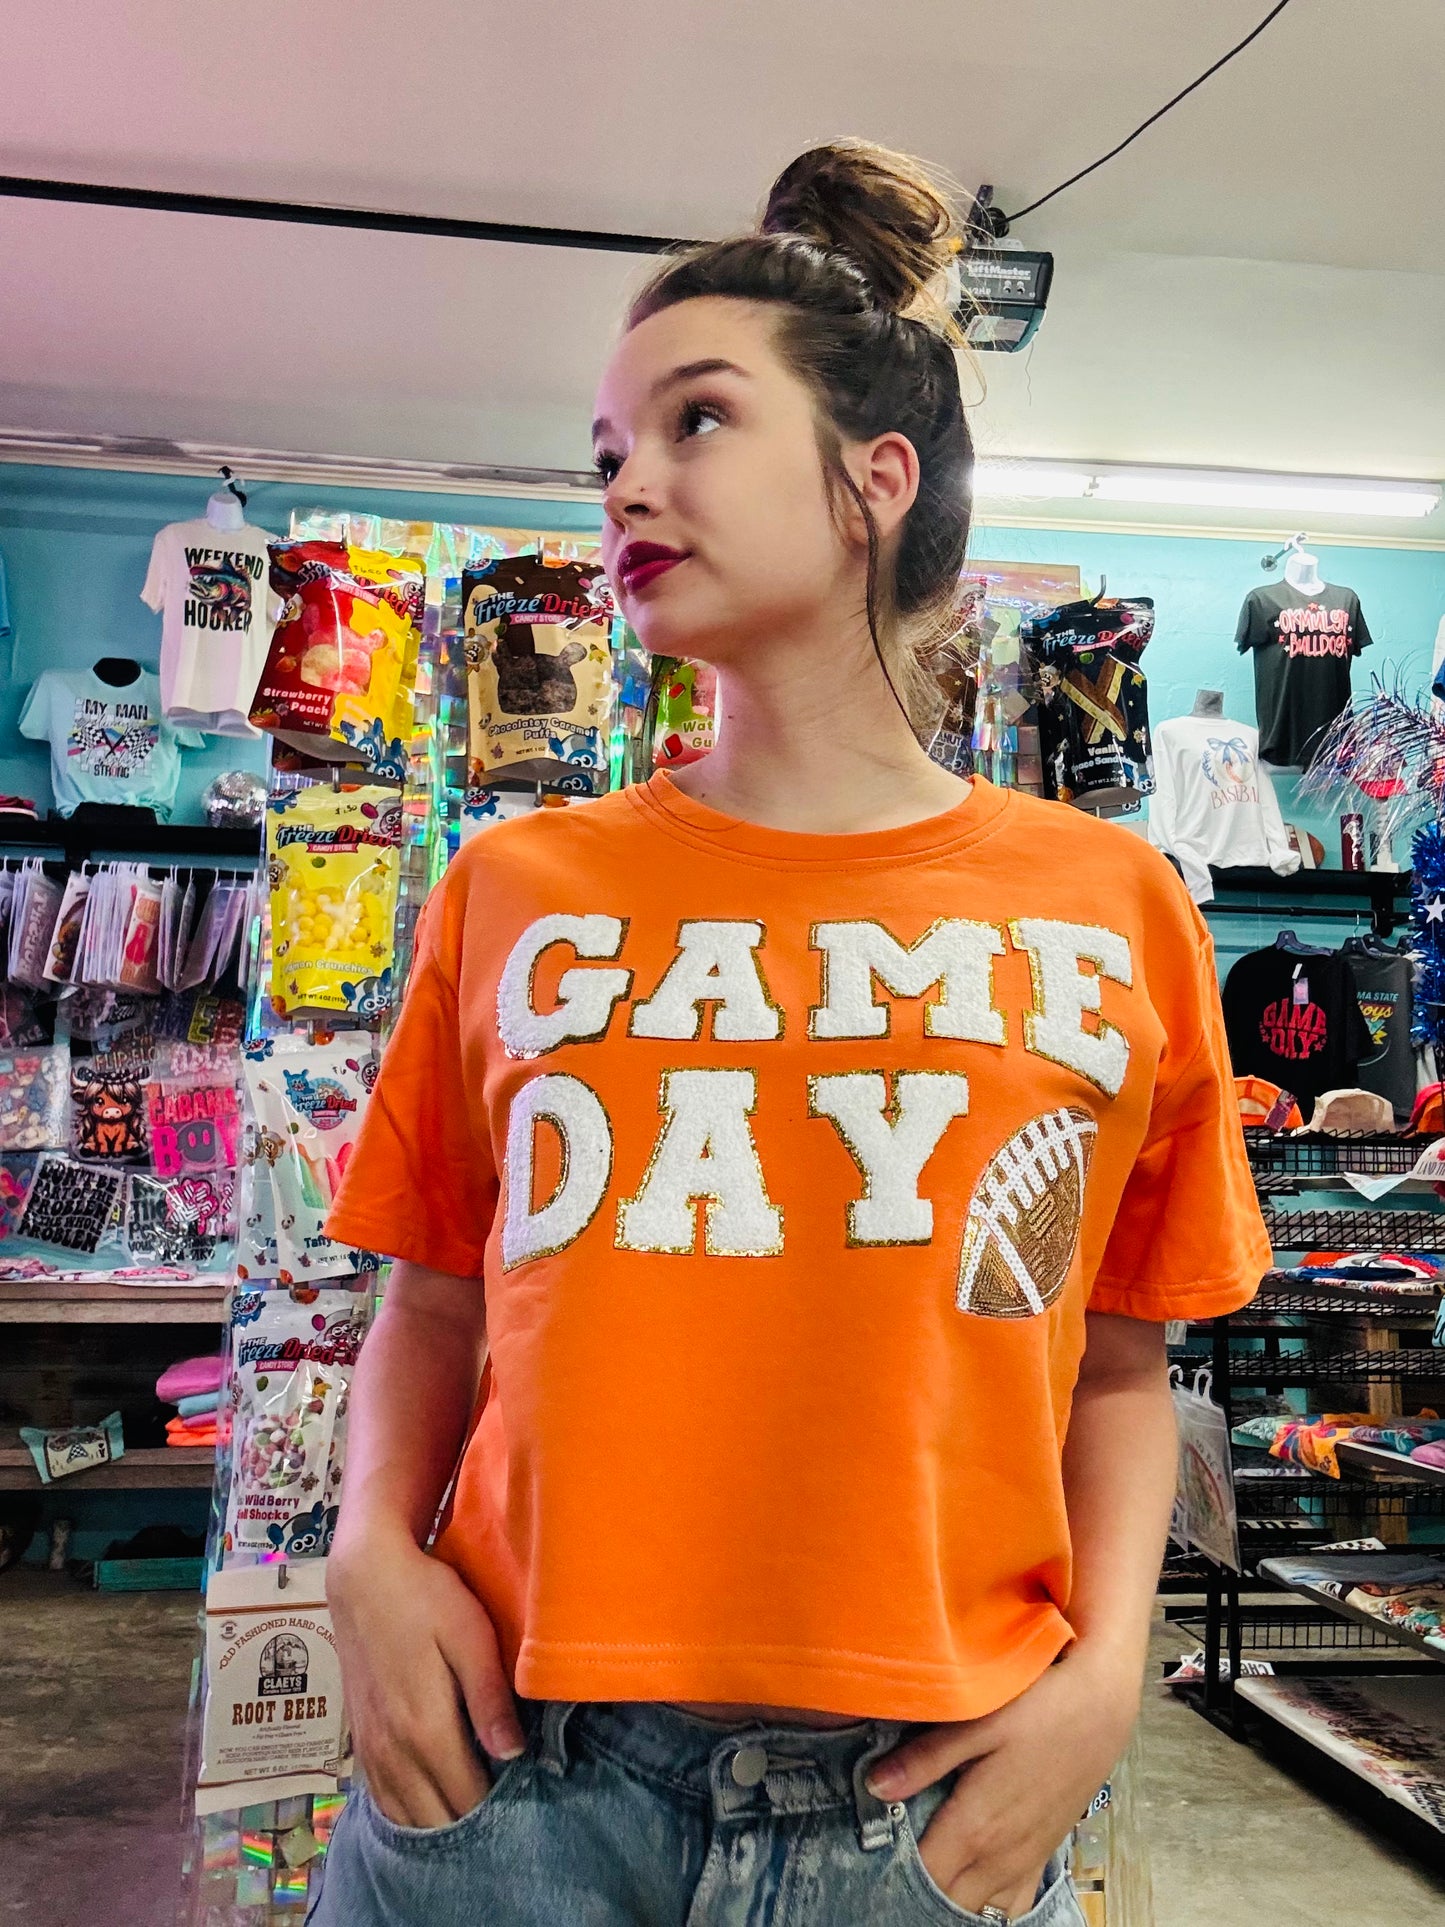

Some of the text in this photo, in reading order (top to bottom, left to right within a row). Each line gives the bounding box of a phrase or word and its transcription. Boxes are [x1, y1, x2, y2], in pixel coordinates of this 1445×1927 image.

[184, 547, 264, 580] WEEKEND
[489, 591, 514, 600] THE
[184, 599, 253, 634] HOOKER
[475, 597, 540, 625] Freeze
[514, 614, 538, 623] CANDY
[1043, 633, 1096, 656] Freeze
[1055, 629, 1075, 638] THE
[262, 687, 333, 705] Strawberry
[85, 699, 108, 717] MY
[116, 703, 148, 721] MAN
[290, 701, 330, 716] Peach
[488, 717, 594, 737] Chocolatey Caramel
[277, 825, 392, 847] Freeze Dried
[293, 824, 314, 832] THE
[496, 914, 1133, 1099] GAME
[1374, 992, 1400, 1002] STATE
[1263, 997, 1327, 1035] GAME
[1270, 1028, 1319, 1060] DAY
[502, 1067, 969, 1274] DAY
[96, 1174, 119, 1194] BE
[27, 1191, 110, 1224] PROBLEM
[17, 1219, 99, 1254] PROBLEM
[239, 1337, 335, 1366] Freeze Dried
[247, 1337, 267, 1346] THE
[245, 1494, 266, 1506] Wild
[266, 1495, 300, 1509] Berry
[249, 1508, 290, 1521] Shocks
[220, 1647, 236, 1669] OLD
[234, 1618, 287, 1649] FASHIONED
[288, 1617, 316, 1630] HARD
[316, 1625, 337, 1648] CAND
[263, 1675, 303, 1690] CLAEYS
[231, 1695, 328, 1726] ROOT BEER
